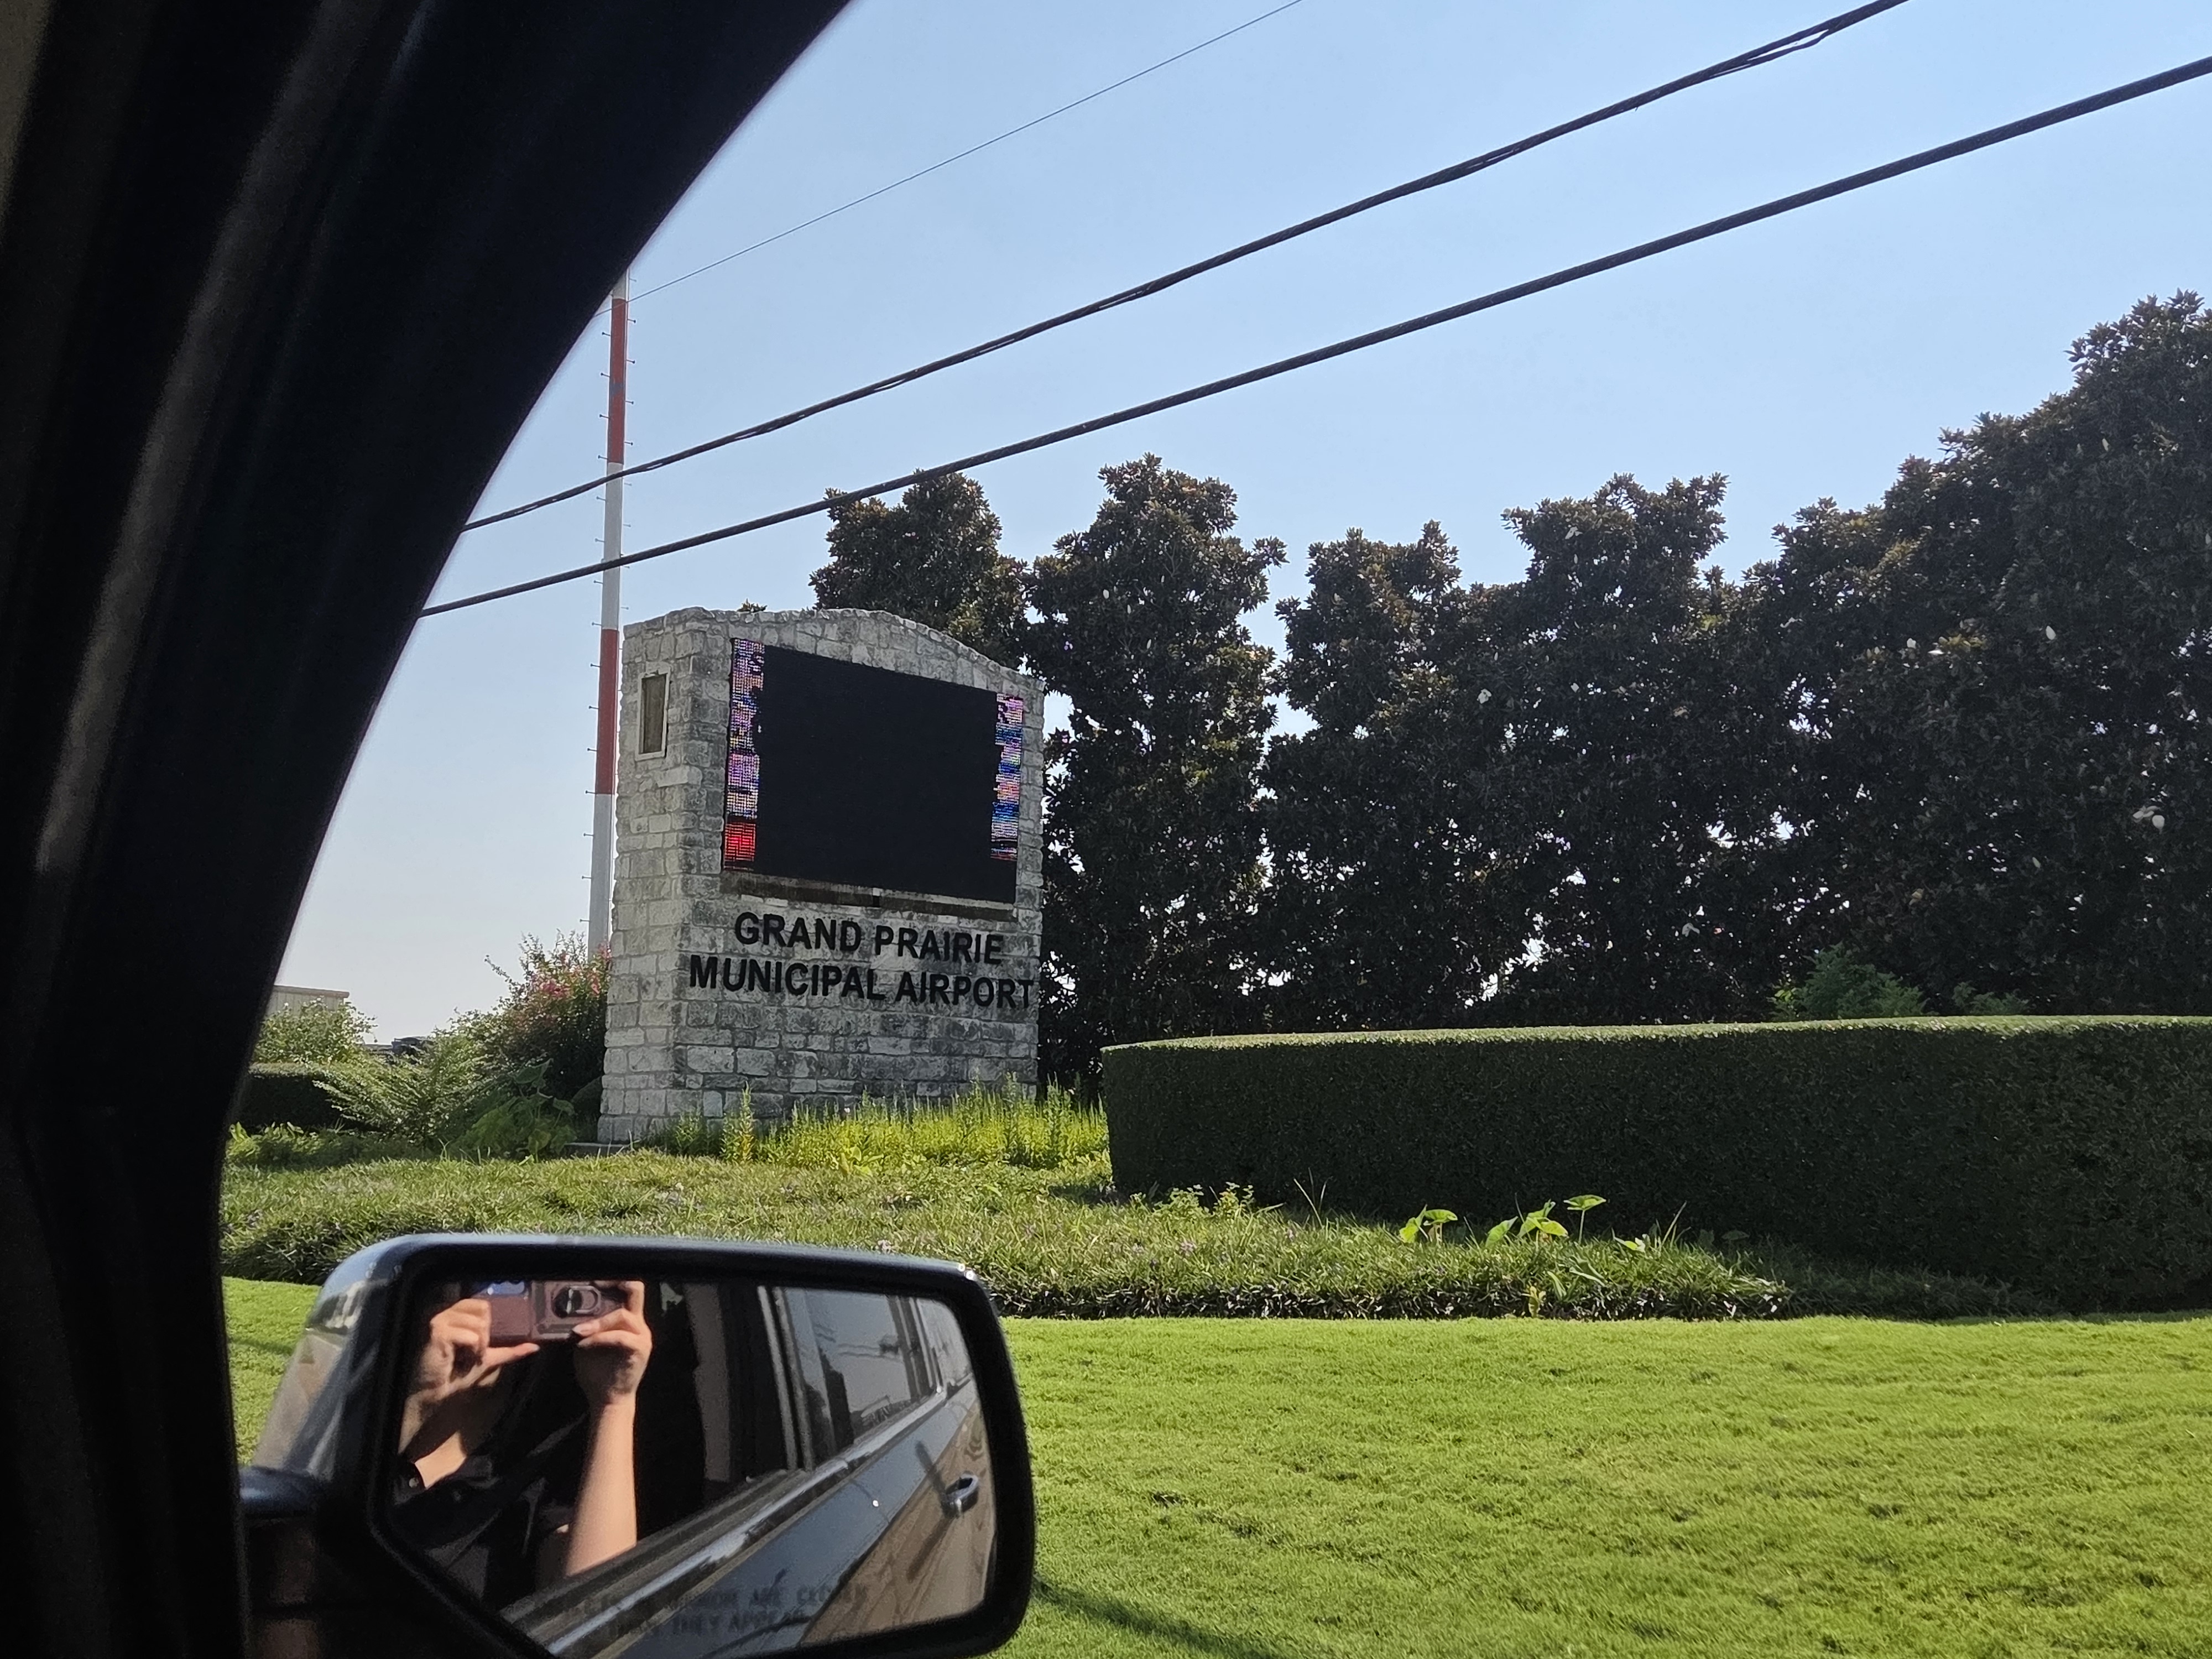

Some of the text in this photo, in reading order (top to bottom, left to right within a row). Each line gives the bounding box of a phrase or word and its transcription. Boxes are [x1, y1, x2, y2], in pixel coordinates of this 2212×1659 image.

[734, 911, 1003, 964] GRAND PRAIRIE
[690, 955, 1034, 1008] MUNICIPAL AIRPORT
